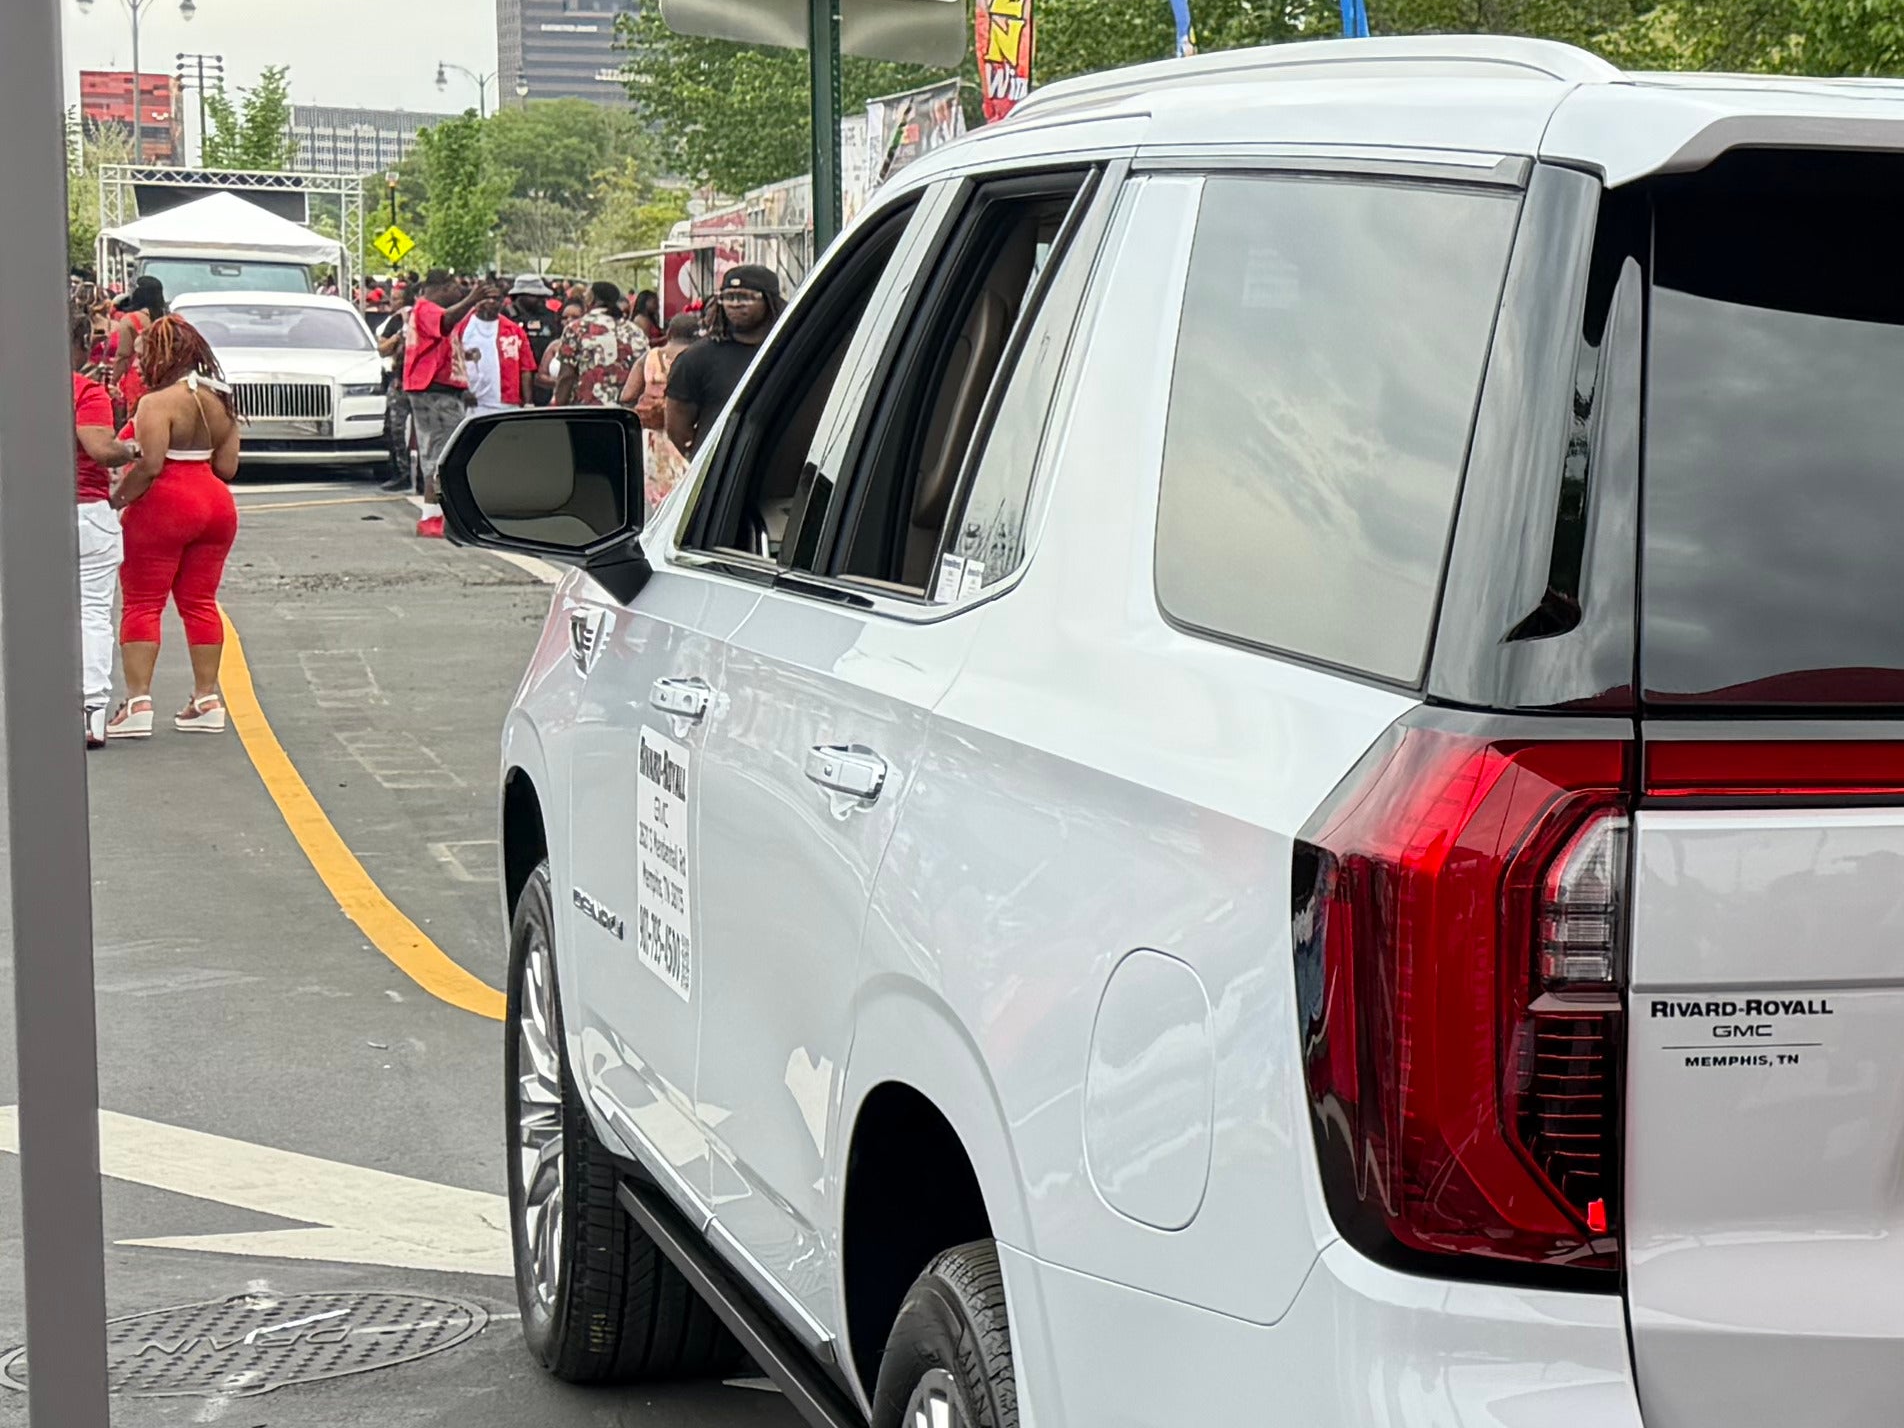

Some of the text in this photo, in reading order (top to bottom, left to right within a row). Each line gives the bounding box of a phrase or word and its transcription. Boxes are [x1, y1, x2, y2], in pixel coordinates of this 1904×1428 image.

[1651, 1000, 1833, 1018] RIVARD-ROYALL
[1713, 1025, 1773, 1037] GMC
[1685, 1054, 1799, 1067] MEMPHIS, TN
